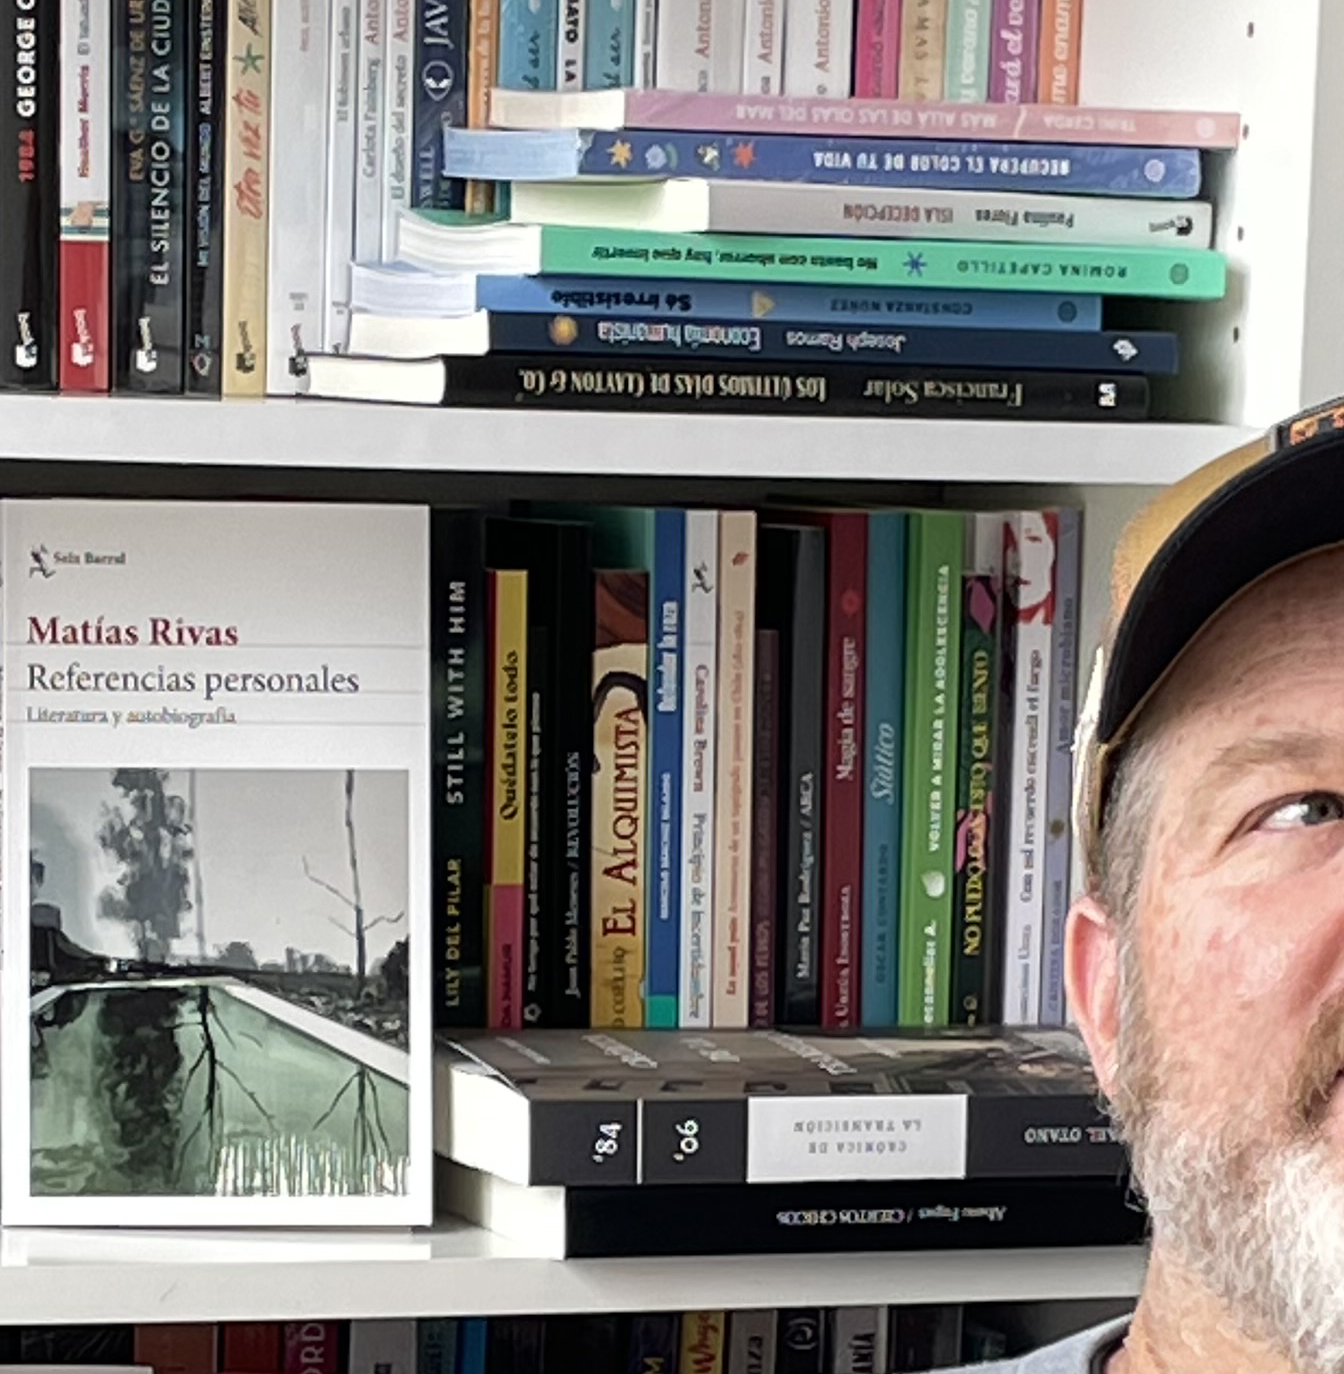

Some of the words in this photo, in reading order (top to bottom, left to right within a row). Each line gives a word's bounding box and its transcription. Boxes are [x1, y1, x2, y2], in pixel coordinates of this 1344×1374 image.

[16, 17, 36, 118] GEORGE
[151, 63, 170, 93] LA
[151, 101, 171, 131] DE
[815, 151, 853, 170] VIDA
[858, 152, 878, 171] TU
[883, 153, 905, 171] DE
[910, 153, 961, 173] COLOR
[966, 154, 985, 173] EL
[990, 155, 1071, 177] RECUPERA
[151, 140, 171, 253] SILENCIO
[150, 261, 170, 285] EL
[956, 259, 1054, 278] CAPETILLO
[1058, 261, 1127, 280] ROMINA
[597, 321, 683, 349] humanista
[685, 323, 762, 352] Economía
[786, 330, 843, 350] Ramos
[846, 330, 907, 352] Joseph
[863, 377, 920, 404] Solar
[923, 379, 1024, 407] Francisca
[449, 580, 466, 633] HIM
[25, 616, 139, 646] Matías
[149, 617, 239, 647] Rivas
[840, 637, 861, 697] sangre
[26, 661, 197, 692] Referencias
[203, 664, 360, 701] personales
[447, 647, 465, 719] WITH
[25, 706, 108, 724] Literatura
[112, 711, 123, 728] y
[125, 706, 237, 729] autobiografía
[837, 699, 857, 720] de
[836, 724, 858, 782] Magia
[446, 731, 465, 805] STILL
